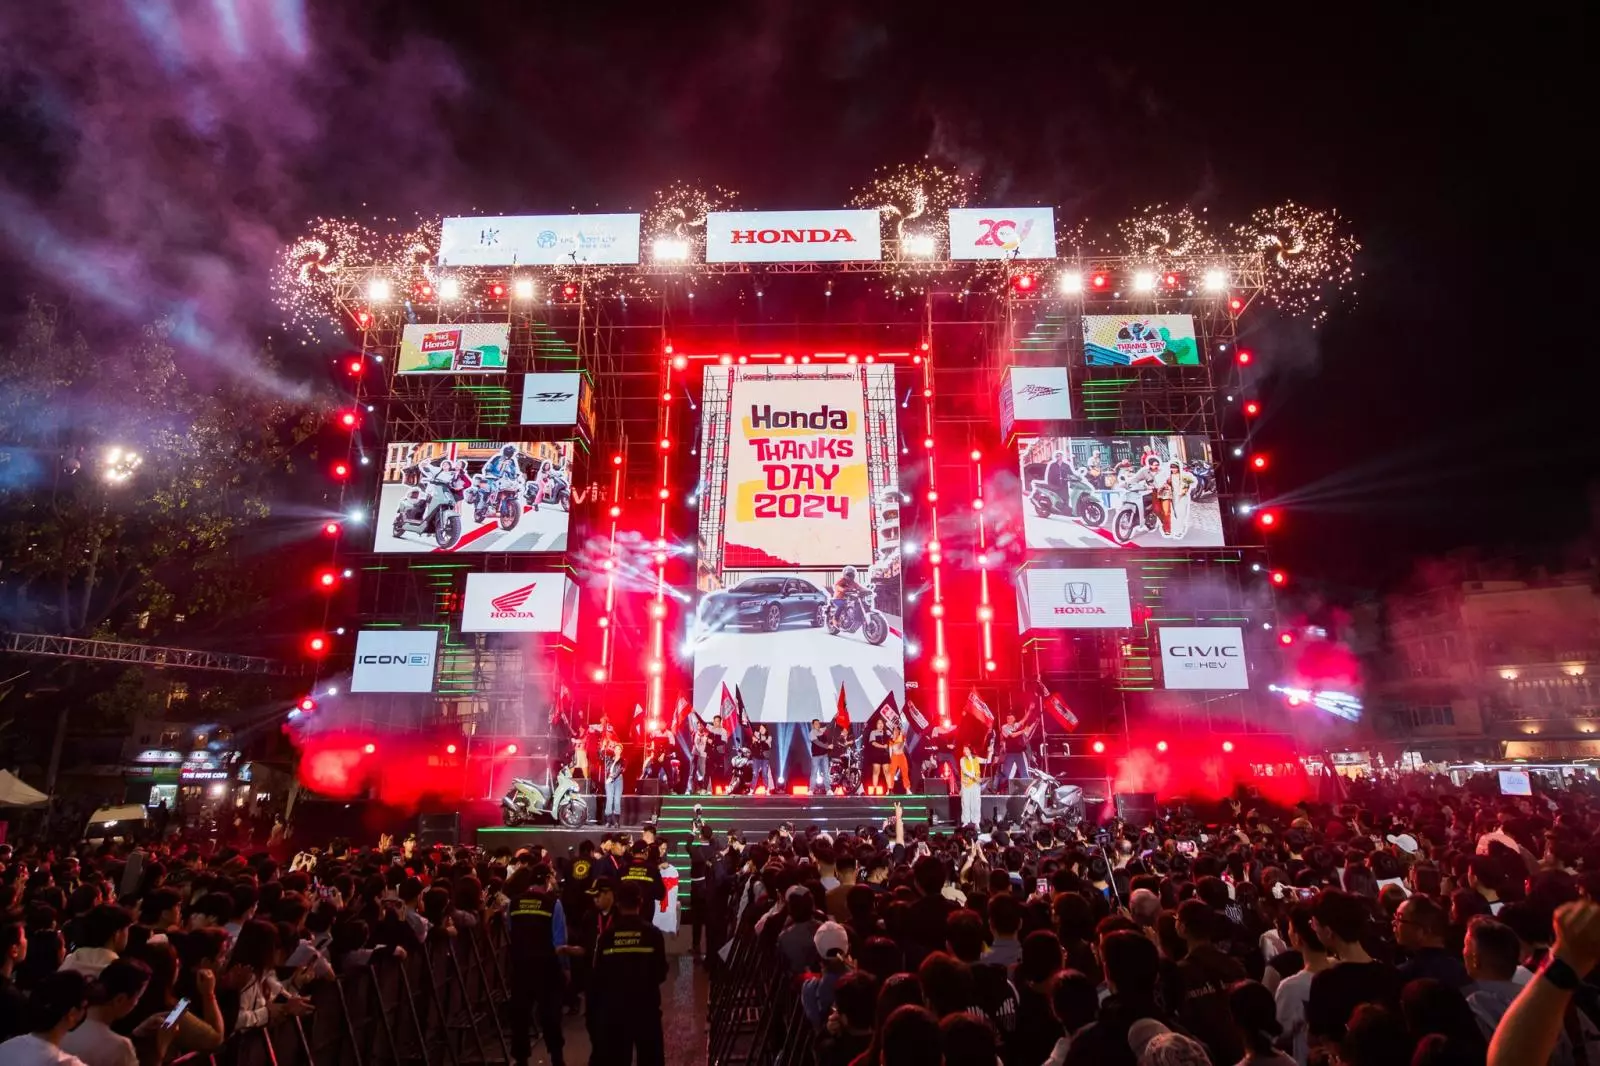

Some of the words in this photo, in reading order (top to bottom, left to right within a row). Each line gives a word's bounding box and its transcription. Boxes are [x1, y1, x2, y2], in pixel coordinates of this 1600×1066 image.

[730, 229, 857, 244] HONDA
[425, 339, 455, 348] Honda
[1117, 342, 1148, 350] THANKS
[1150, 341, 1166, 349] DAY
[751, 405, 848, 429] Honda
[762, 464, 840, 490] DAY
[754, 494, 849, 519] 2024
[1169, 646, 1239, 657] CIVIC
[358, 655, 407, 665] ICON
